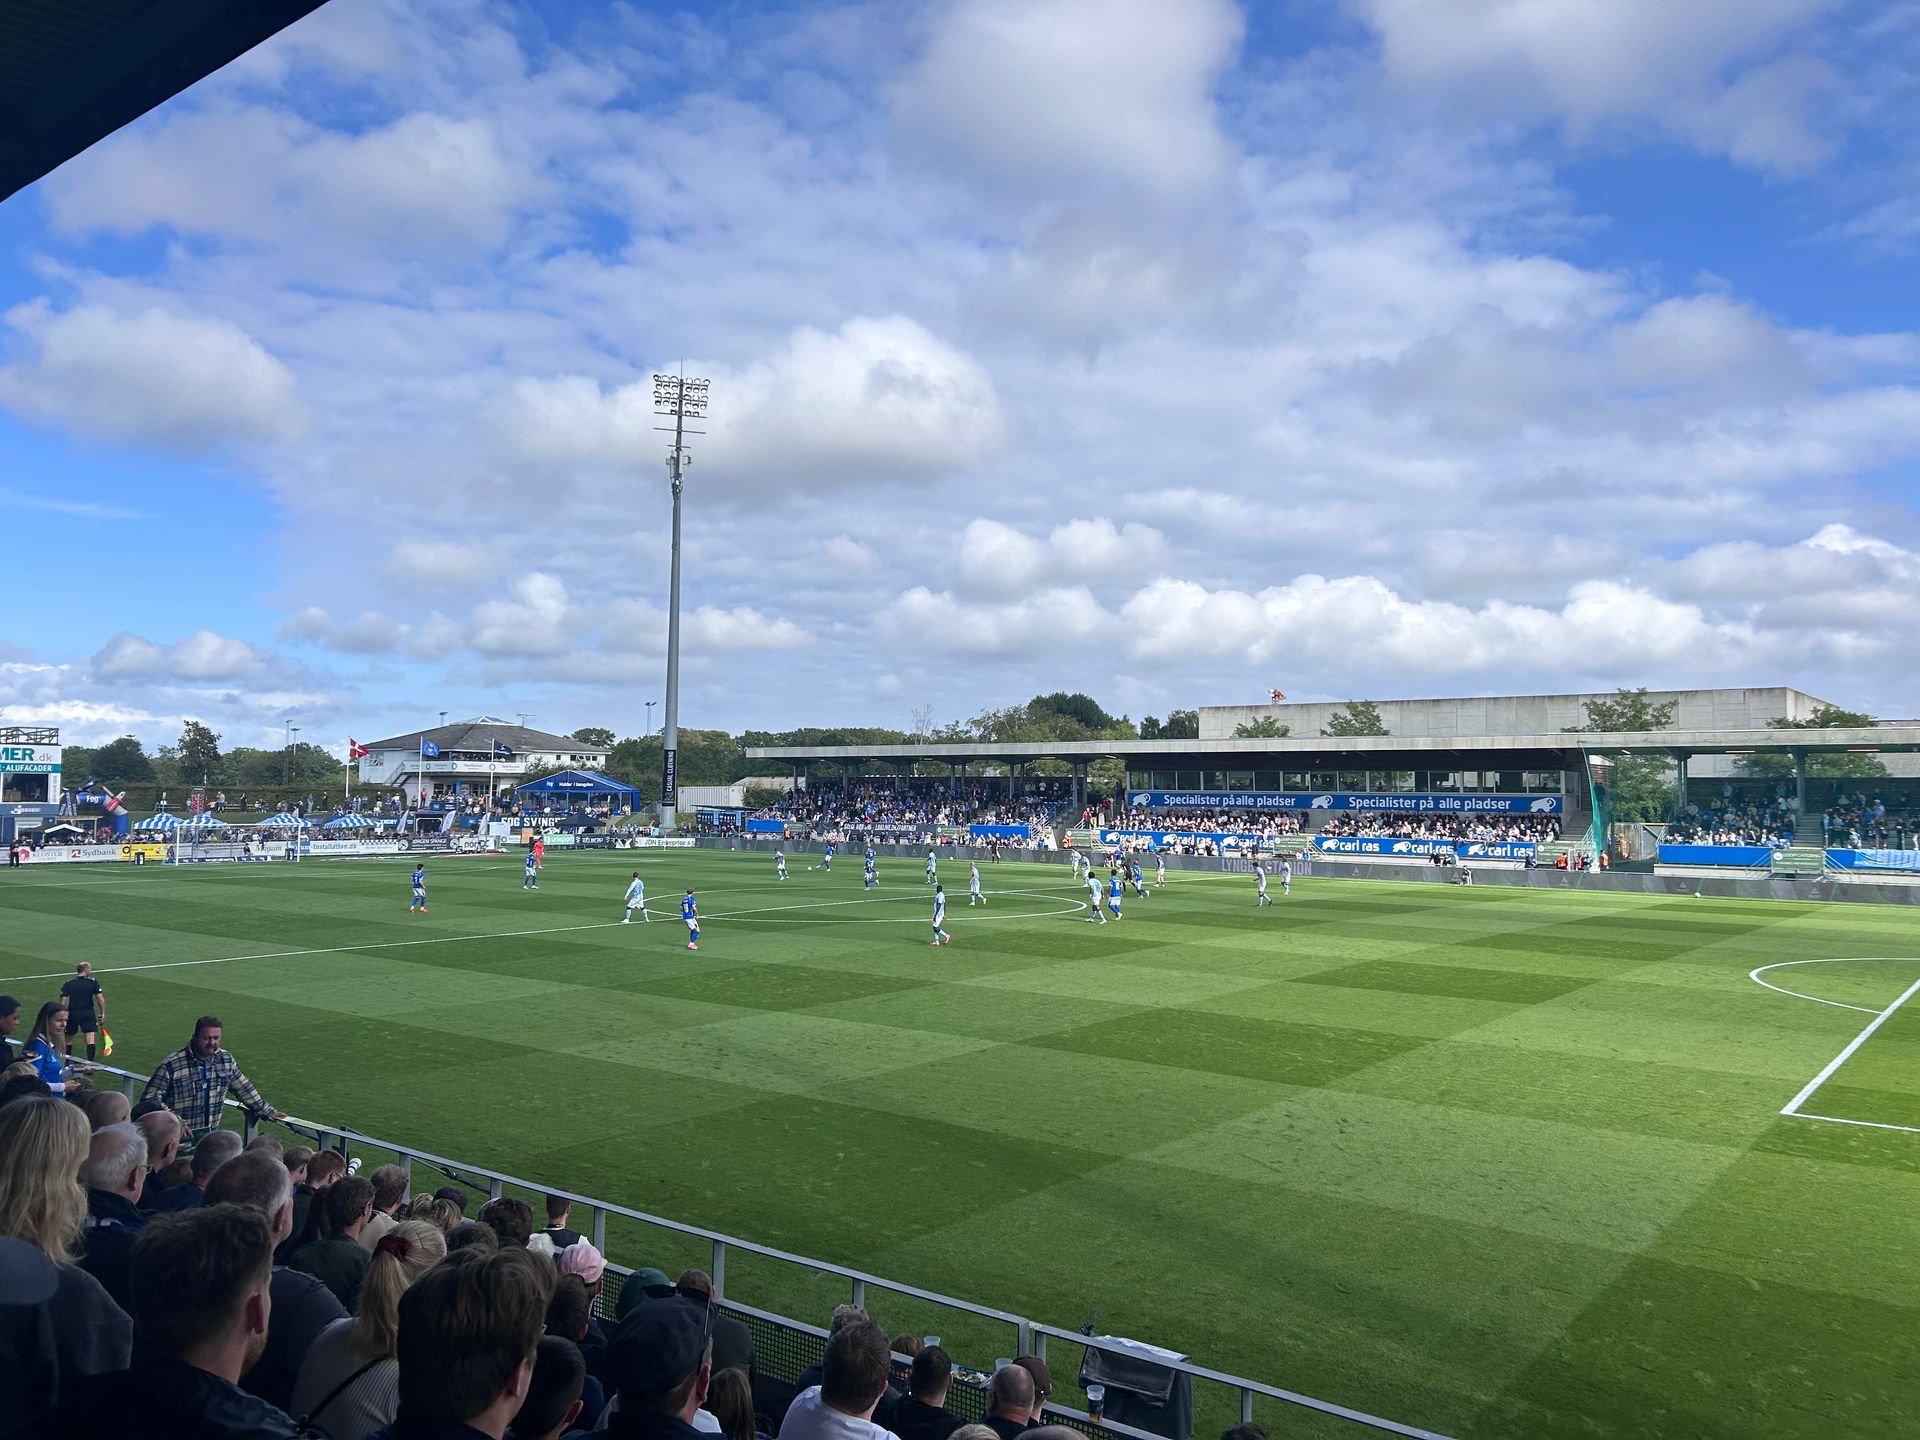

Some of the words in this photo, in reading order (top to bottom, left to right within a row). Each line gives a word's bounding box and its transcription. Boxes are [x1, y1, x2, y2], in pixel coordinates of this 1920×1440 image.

[6, 764, 52, 772] ALUFACADER
[86, 795, 99, 804] Fog
[1163, 794, 1220, 806] Specialister
[1222, 794, 1236, 807] på
[1236, 795, 1254, 806] alle
[1257, 795, 1295, 807] pladser
[1349, 796, 1416, 809] Specialister
[1419, 796, 1434, 810] på
[1439, 797, 1460, 809] alle
[1464, 797, 1511, 811] pladser
[1339, 840, 1359, 851] carl
[1362, 842, 1380, 852] ras
[1411, 841, 1433, 854] carl
[1435, 845, 1454, 855] ras
[1488, 844, 1510, 856] carl
[82, 849, 117, 858] Sydbank
